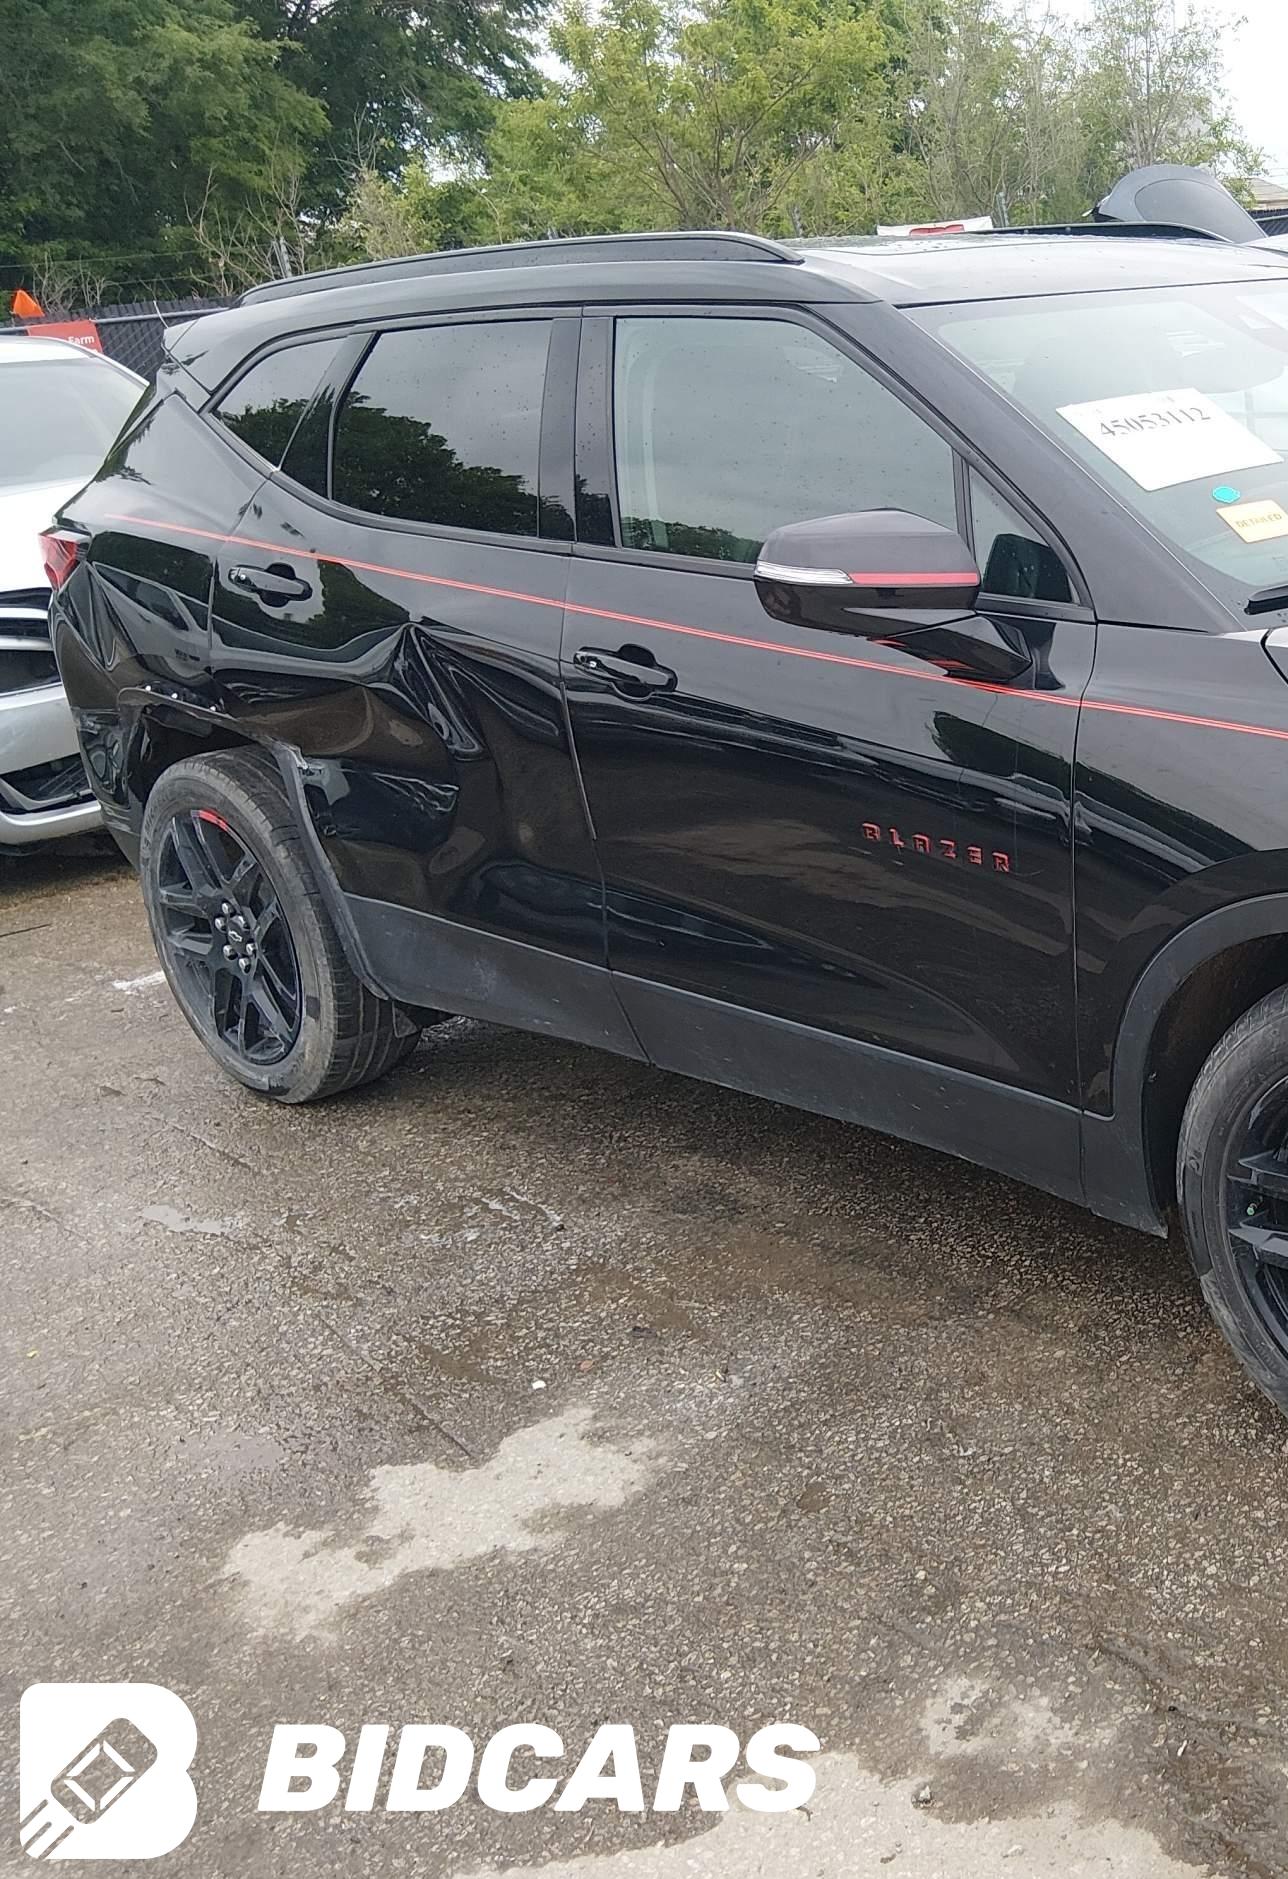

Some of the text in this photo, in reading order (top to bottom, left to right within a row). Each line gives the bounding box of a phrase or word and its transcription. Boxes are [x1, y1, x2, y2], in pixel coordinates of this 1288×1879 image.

[68, 336, 95, 345] Farm
[1100, 407, 1211, 436] 45053112
[862, 821, 1010, 873] BLAZER
